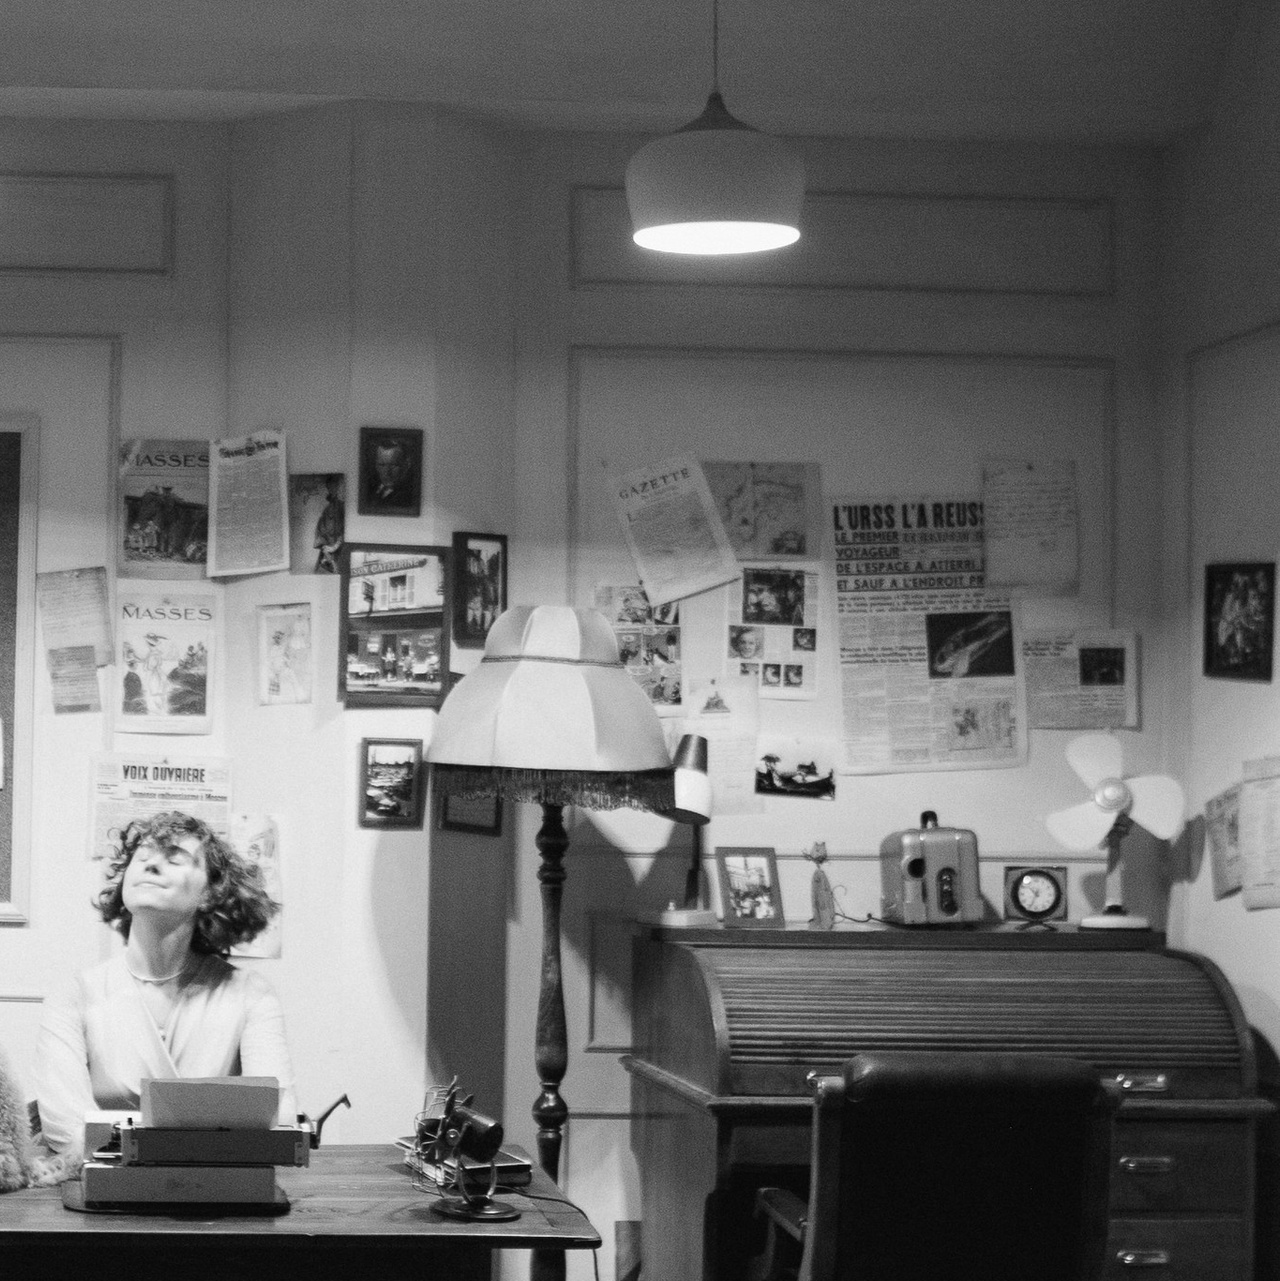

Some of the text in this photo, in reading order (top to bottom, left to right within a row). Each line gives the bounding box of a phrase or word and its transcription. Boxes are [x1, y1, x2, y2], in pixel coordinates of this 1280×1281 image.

[619, 468, 690, 499] GAZETTE
[833, 504, 896, 531] L'URSS
[901, 503, 929, 529] L'A
[834, 531, 848, 543] LE
[852, 530, 899, 542] PREMIER
[835, 546, 900, 558] VOYAGEUR
[836, 562, 851, 574] DE
[856, 561, 910, 573] L'ESPACE
[915, 561, 924, 571] A
[837, 579, 849, 590] ET
[854, 578, 885, 589] SAUF
[889, 577, 898, 587] A
[903, 576, 964, 587] L'ENDROIT
[122, 606, 212, 620] MASSES
[122, 765, 149, 780] VOIX
